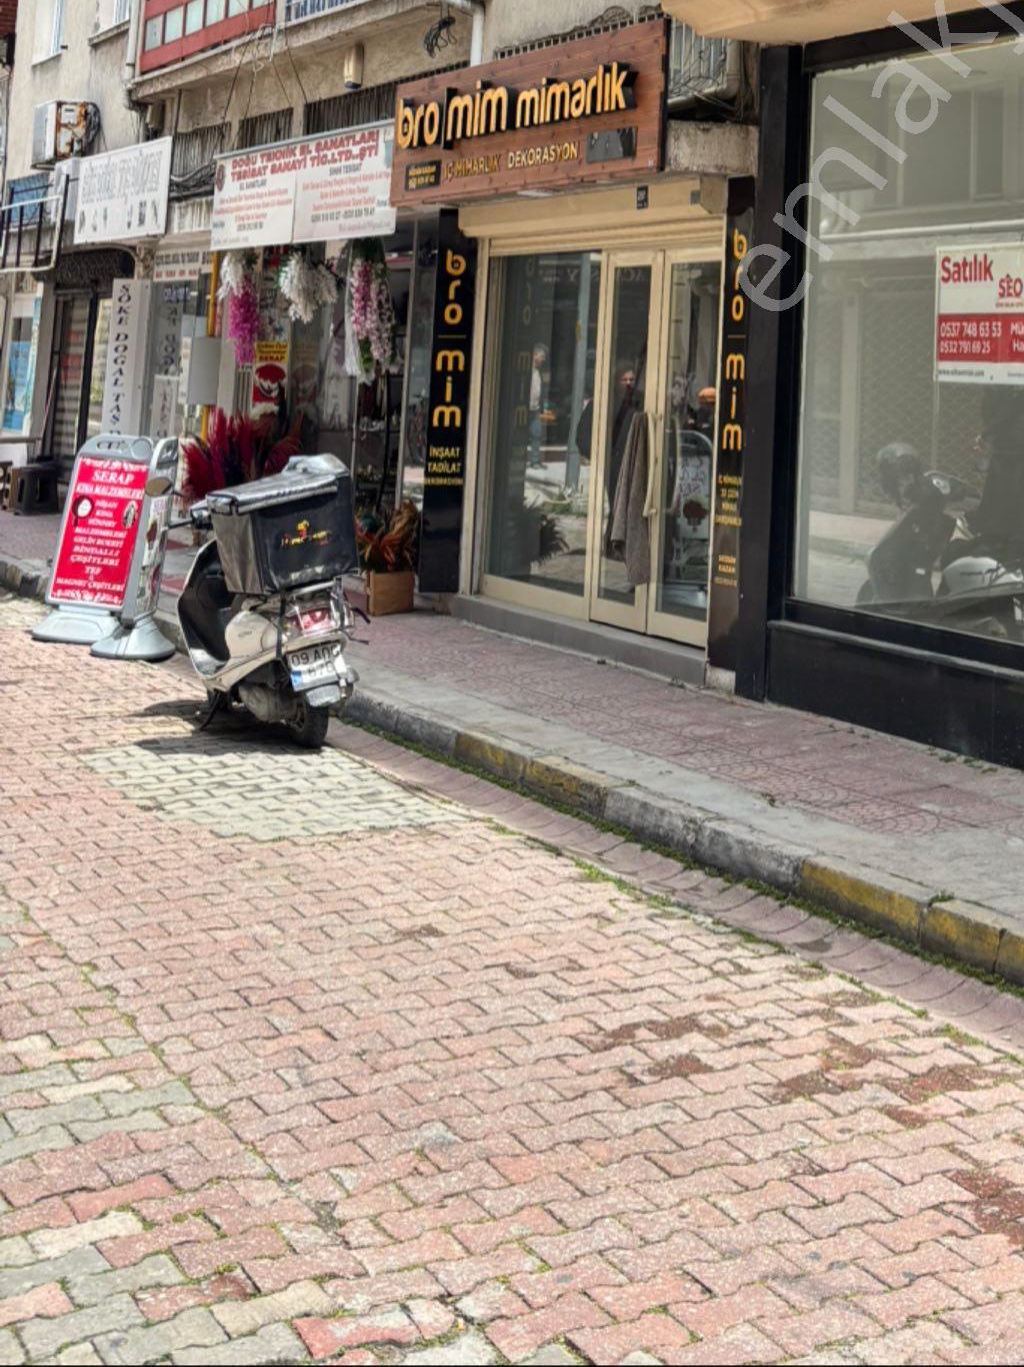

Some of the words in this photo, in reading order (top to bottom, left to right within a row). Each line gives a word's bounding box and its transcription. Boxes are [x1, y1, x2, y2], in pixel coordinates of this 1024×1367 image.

[397, 98, 439, 149] bro
[446, 80, 509, 140] mim
[515, 61, 628, 129] mimarlık
[507, 141, 579, 170] DEKORASYON
[731, 227, 747, 322] bro
[941, 253, 994, 283] Satılık
[444, 249, 466, 325] bro
[940, 322, 960, 338] 0537
[432, 349, 465, 427] mim
[722, 353, 745, 451] mim
[429, 445, 460, 459] İNŞAAT
[92, 471, 135, 485] SERAP
[427, 461, 462, 474] TADİLAT
[291, 652, 309, 667] 09
